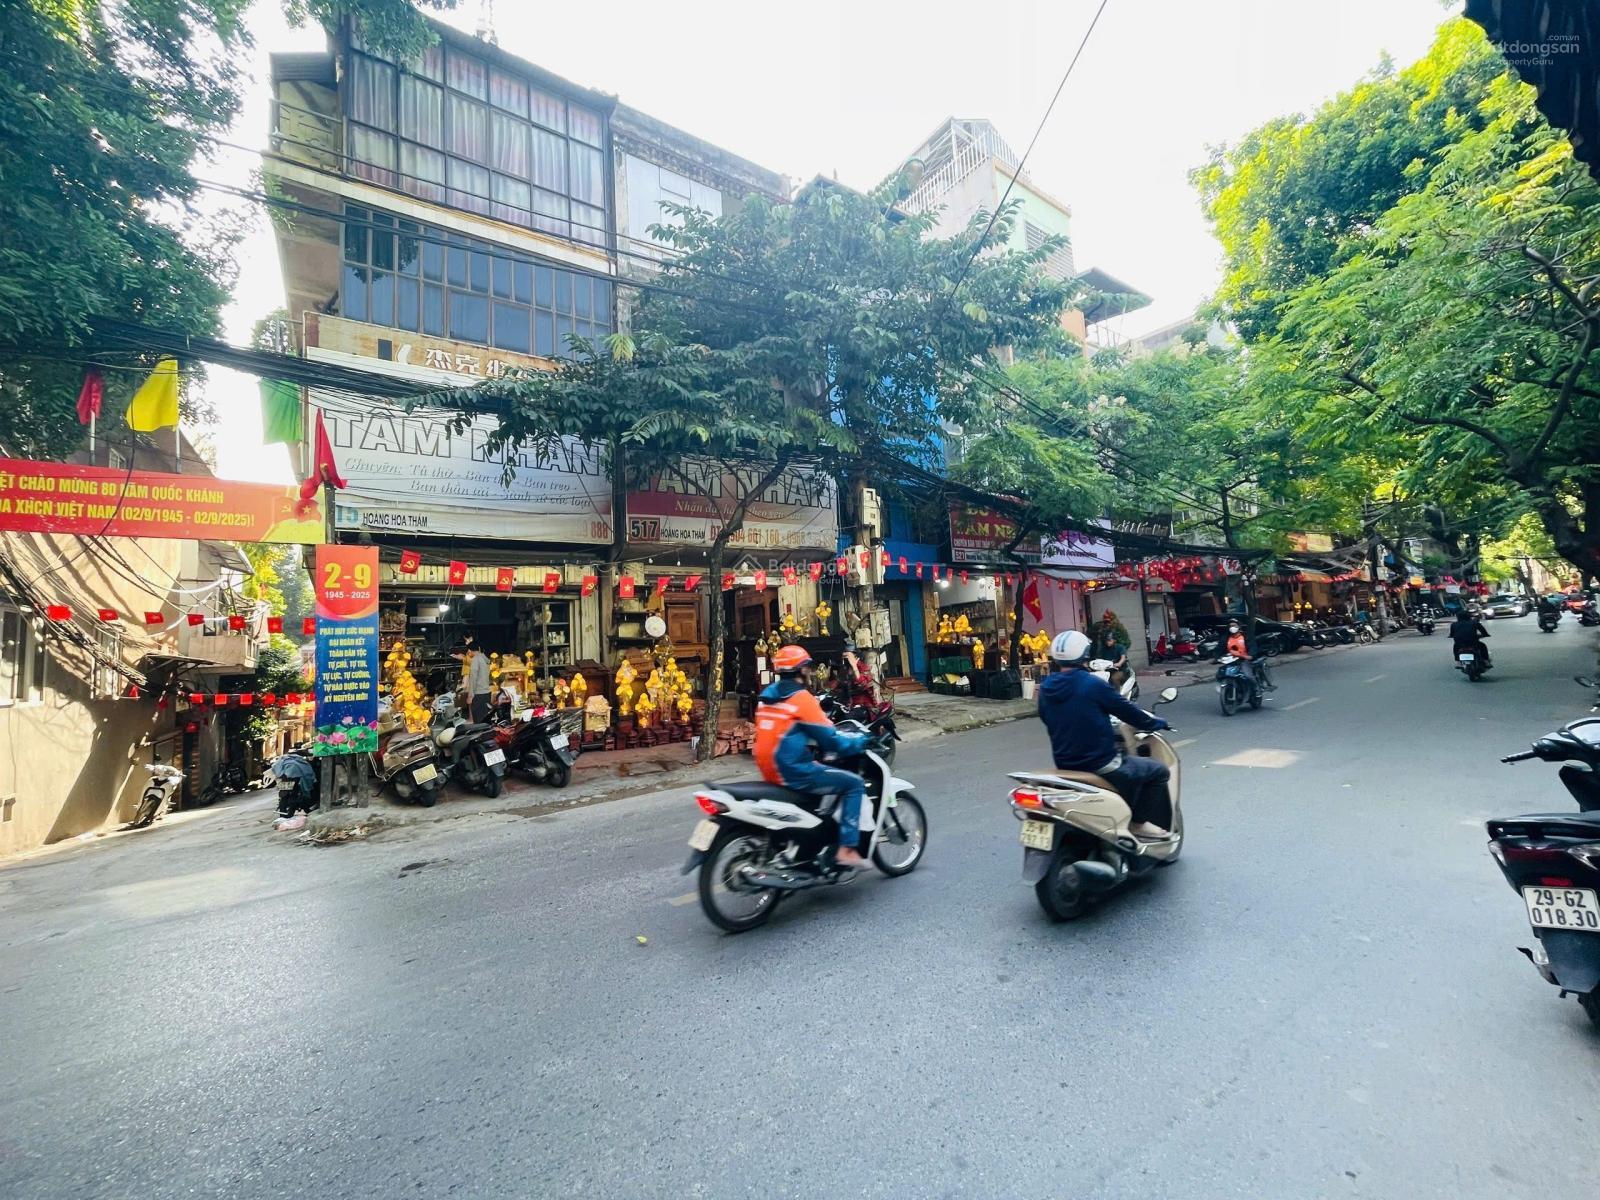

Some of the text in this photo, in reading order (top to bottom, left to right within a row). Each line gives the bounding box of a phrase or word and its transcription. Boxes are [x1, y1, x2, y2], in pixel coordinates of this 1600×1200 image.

[323, 406, 452, 459] TÂM
[59, 477, 98, 495] MỪNG
[101, 483, 117, 497] 80
[120, 482, 148, 499] NĂM
[152, 482, 183, 502] QUỐC
[186, 487, 224, 504] KHÁNH
[15, 500, 52, 515] XHCN
[57, 500, 84, 520] VIỆT
[87, 504, 117, 519] NAM
[121, 506, 183, 523] (02/9/1945
[194, 511, 255, 527] 02/9/2025)!
[675, 499, 703, 515] Nhận
[631, 520, 658, 538] 517
[325, 591, 344, 599] 1945
[351, 591, 371, 599] 2025
[1533, 889, 1587, 909] 29-G2
[1531, 907, 1598, 928] 018.30
